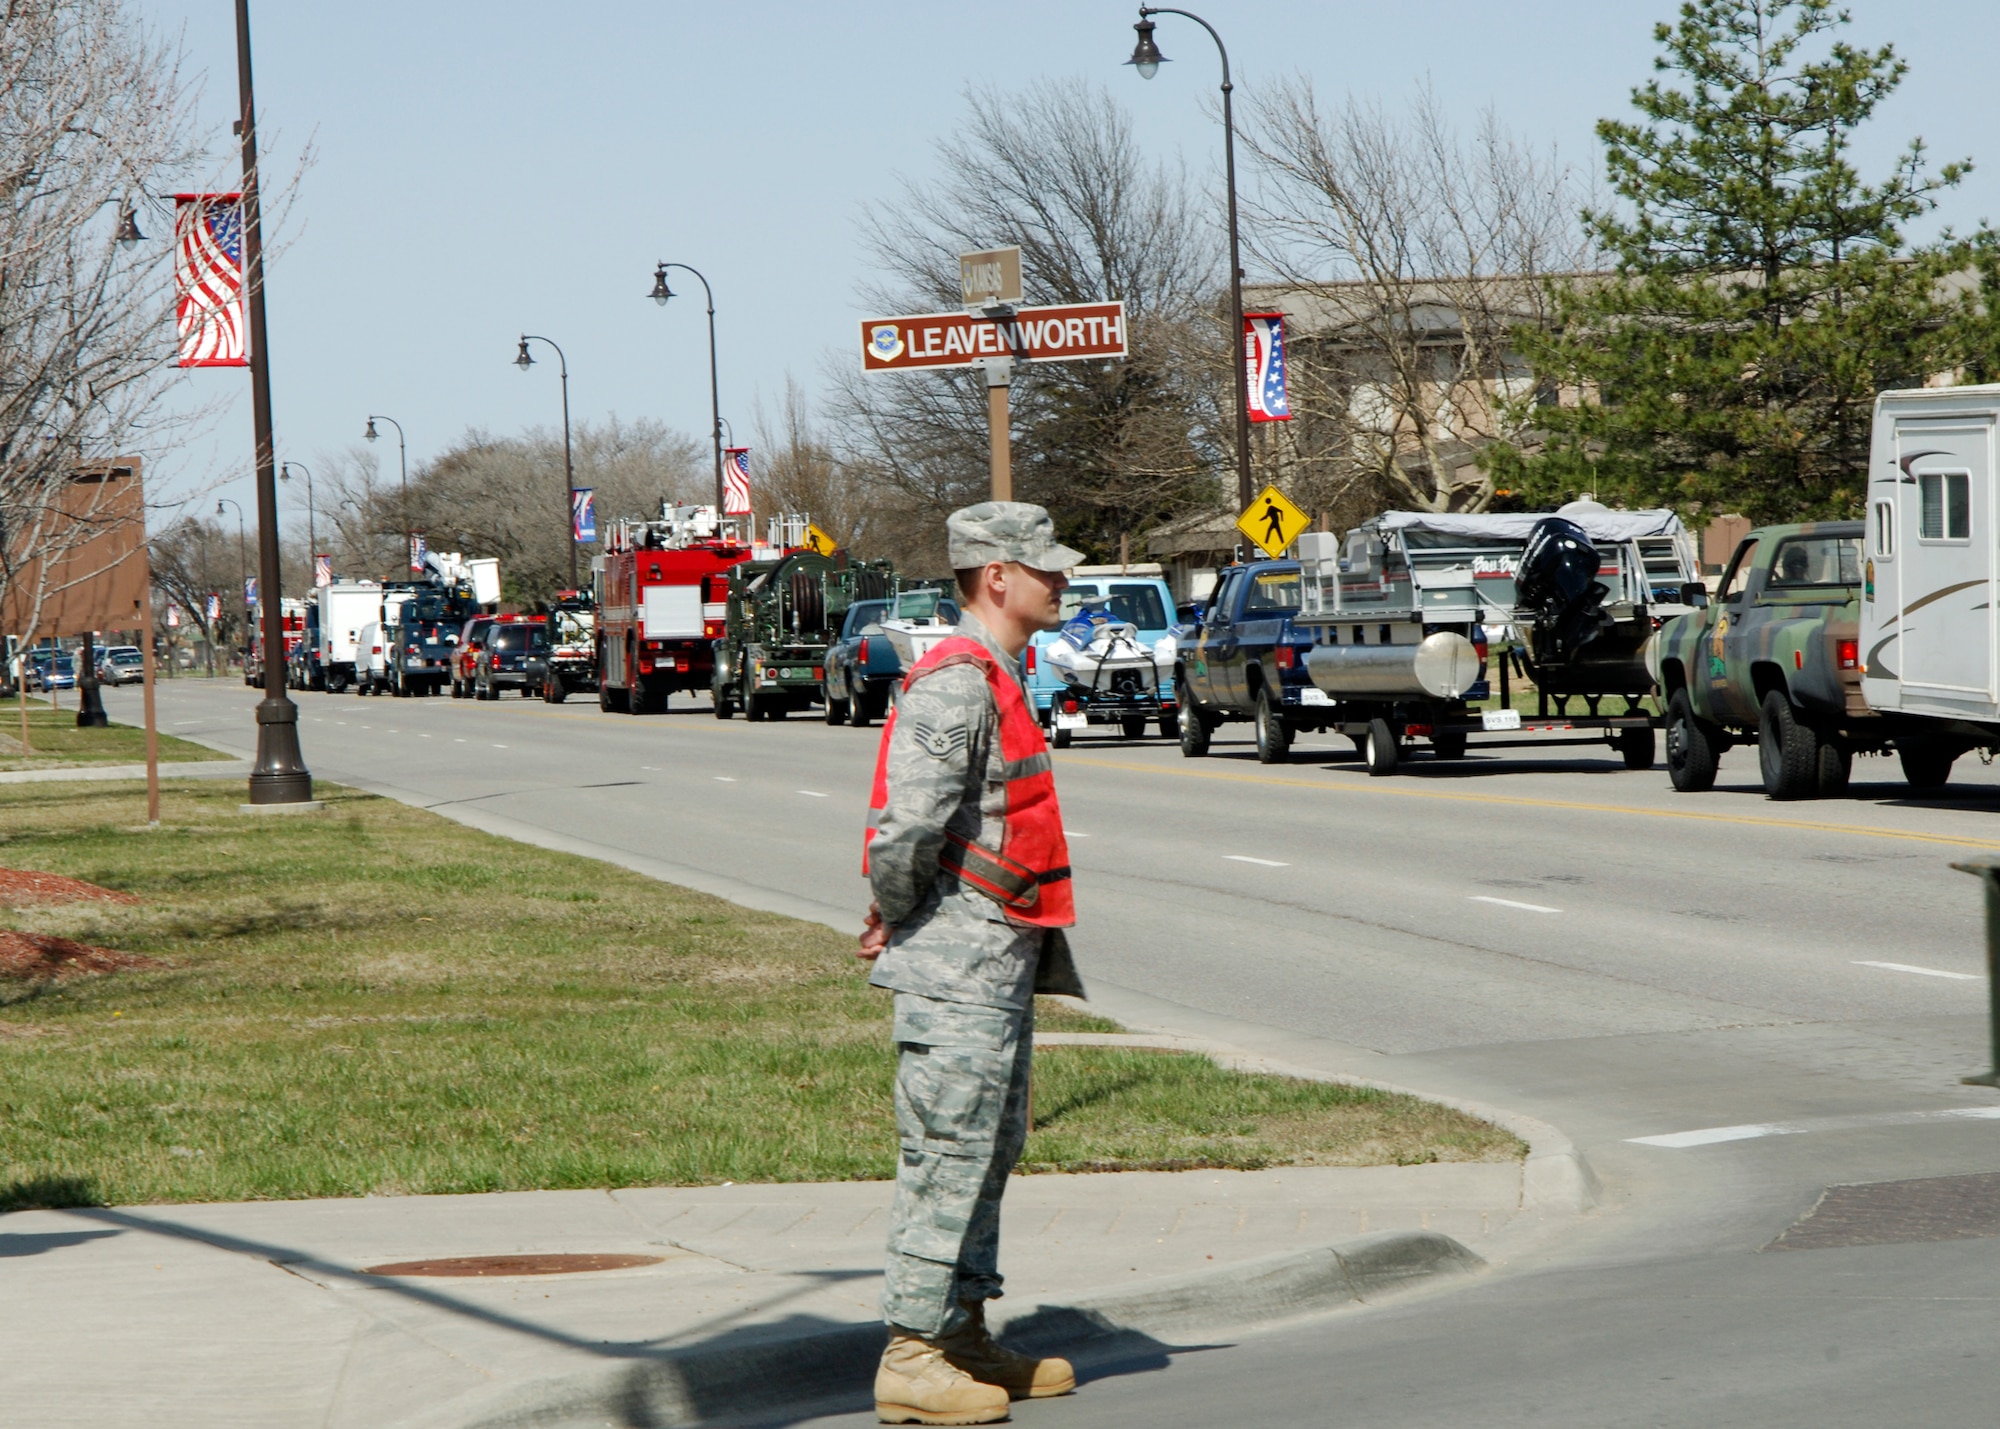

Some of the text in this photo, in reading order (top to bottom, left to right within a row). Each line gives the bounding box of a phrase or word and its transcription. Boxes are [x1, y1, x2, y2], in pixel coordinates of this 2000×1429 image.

[972, 261, 1003, 293] KANSAS
[907, 315, 1123, 358] LEAVENWORTH
[1245, 331, 1263, 411] Team McConnell
